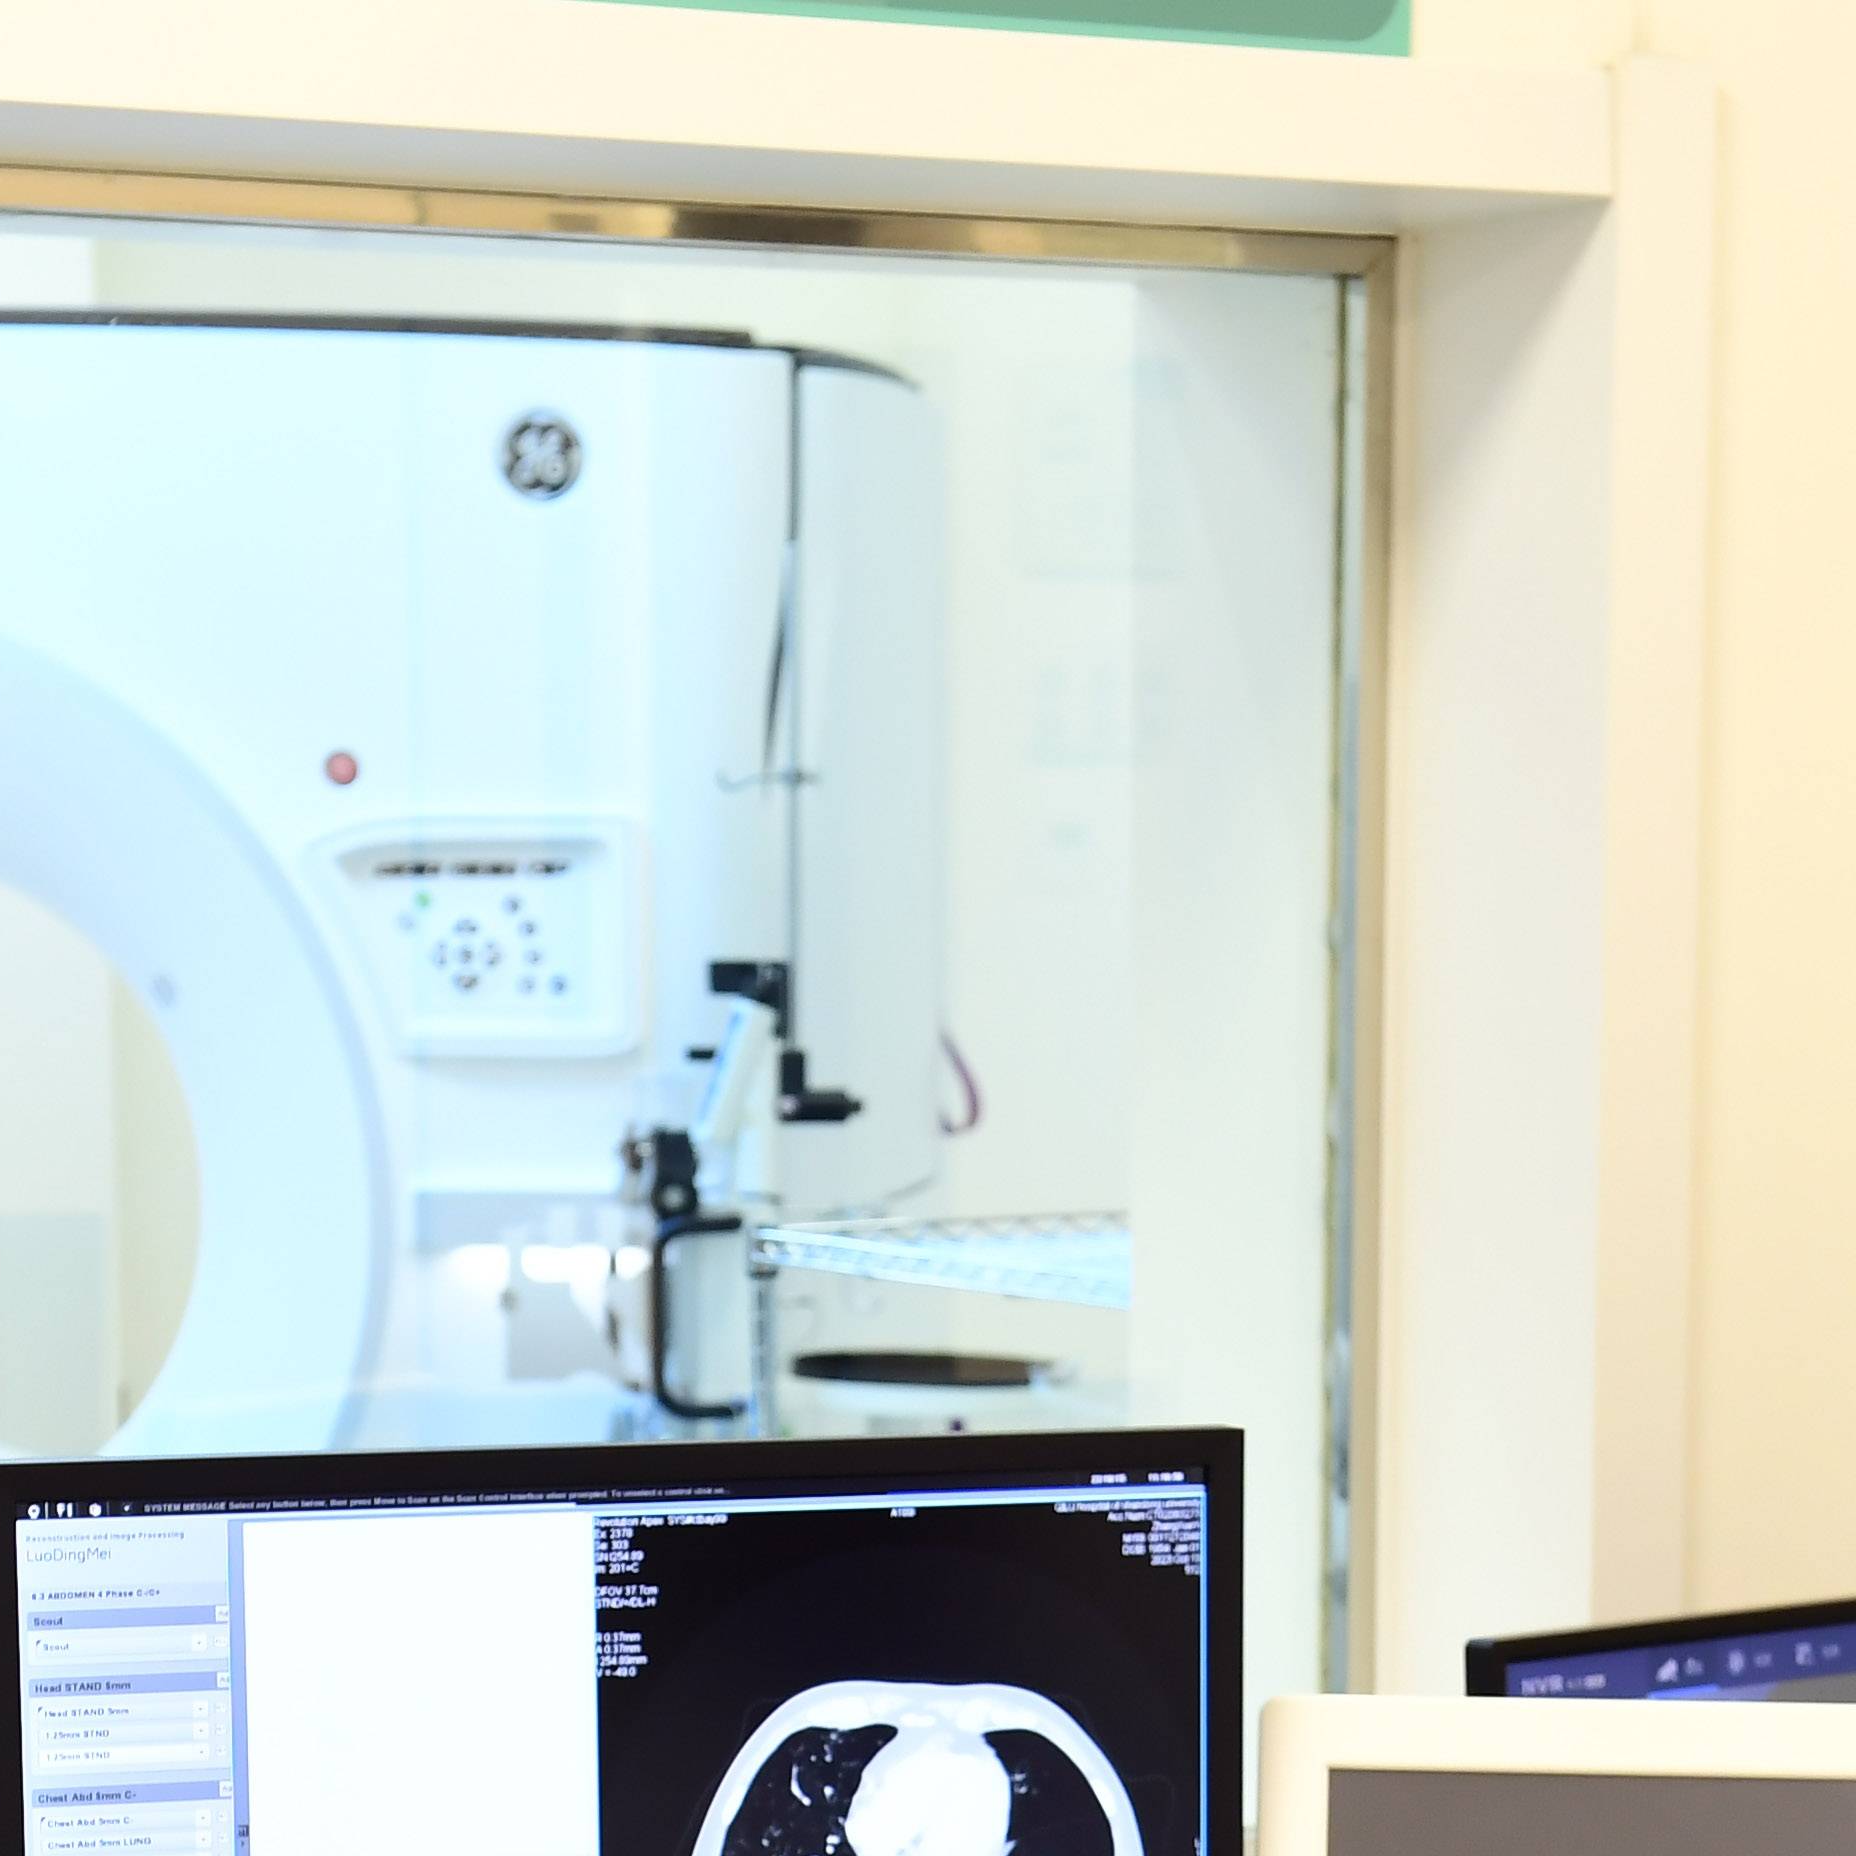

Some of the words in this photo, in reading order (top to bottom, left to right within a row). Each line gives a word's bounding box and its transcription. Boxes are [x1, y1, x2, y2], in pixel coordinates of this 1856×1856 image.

[144, 1504, 181, 1513] SYSTEM
[183, 1502, 227, 1512] MESSAGE
[26, 1548, 112, 1563] LuoDingMei
[33, 1617, 63, 1628] Scout
[35, 1682, 63, 1694] Head
[65, 1681, 102, 1693] STAND
[37, 1793, 69, 1805] Chest
[72, 1792, 94, 1803] Abd
